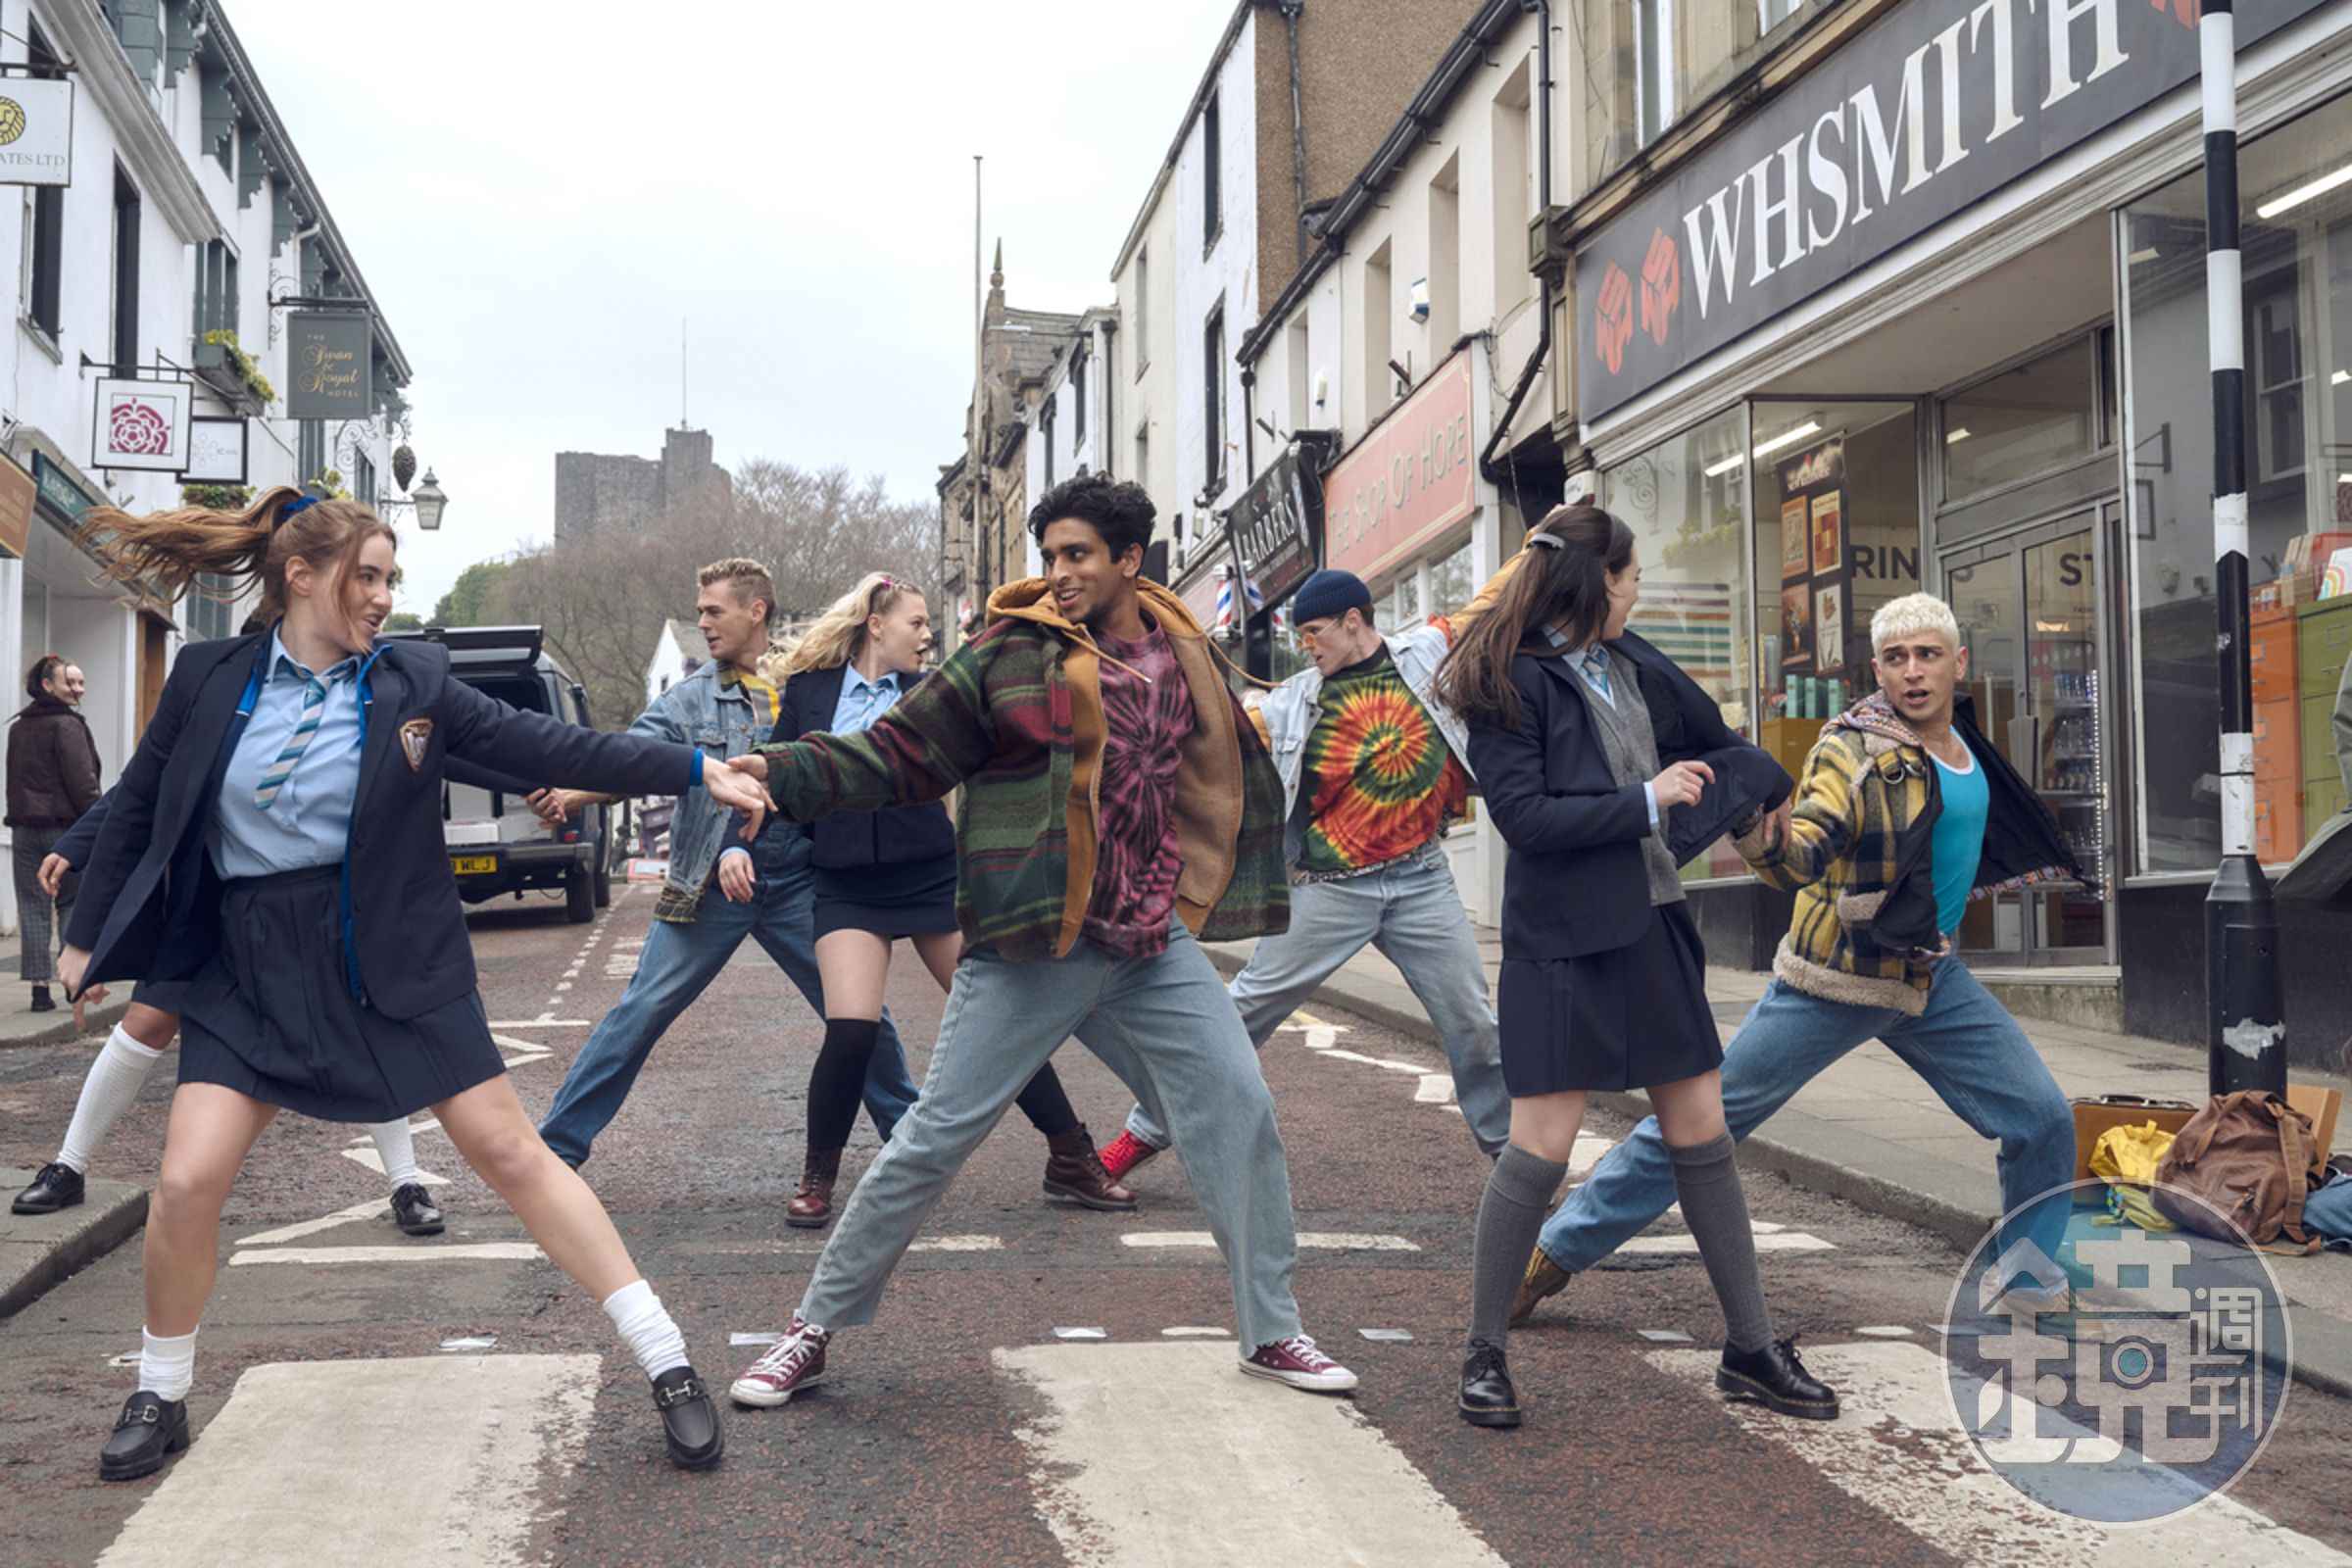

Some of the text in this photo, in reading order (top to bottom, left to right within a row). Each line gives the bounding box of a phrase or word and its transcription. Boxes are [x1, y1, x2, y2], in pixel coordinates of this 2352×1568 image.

[36, 154, 66, 166] LTD
[1683, 0, 2130, 319] WHSMITH
[1242, 492, 1296, 566] BARBERS
[1330, 410, 1467, 564] THE SHOP OF HOPE
